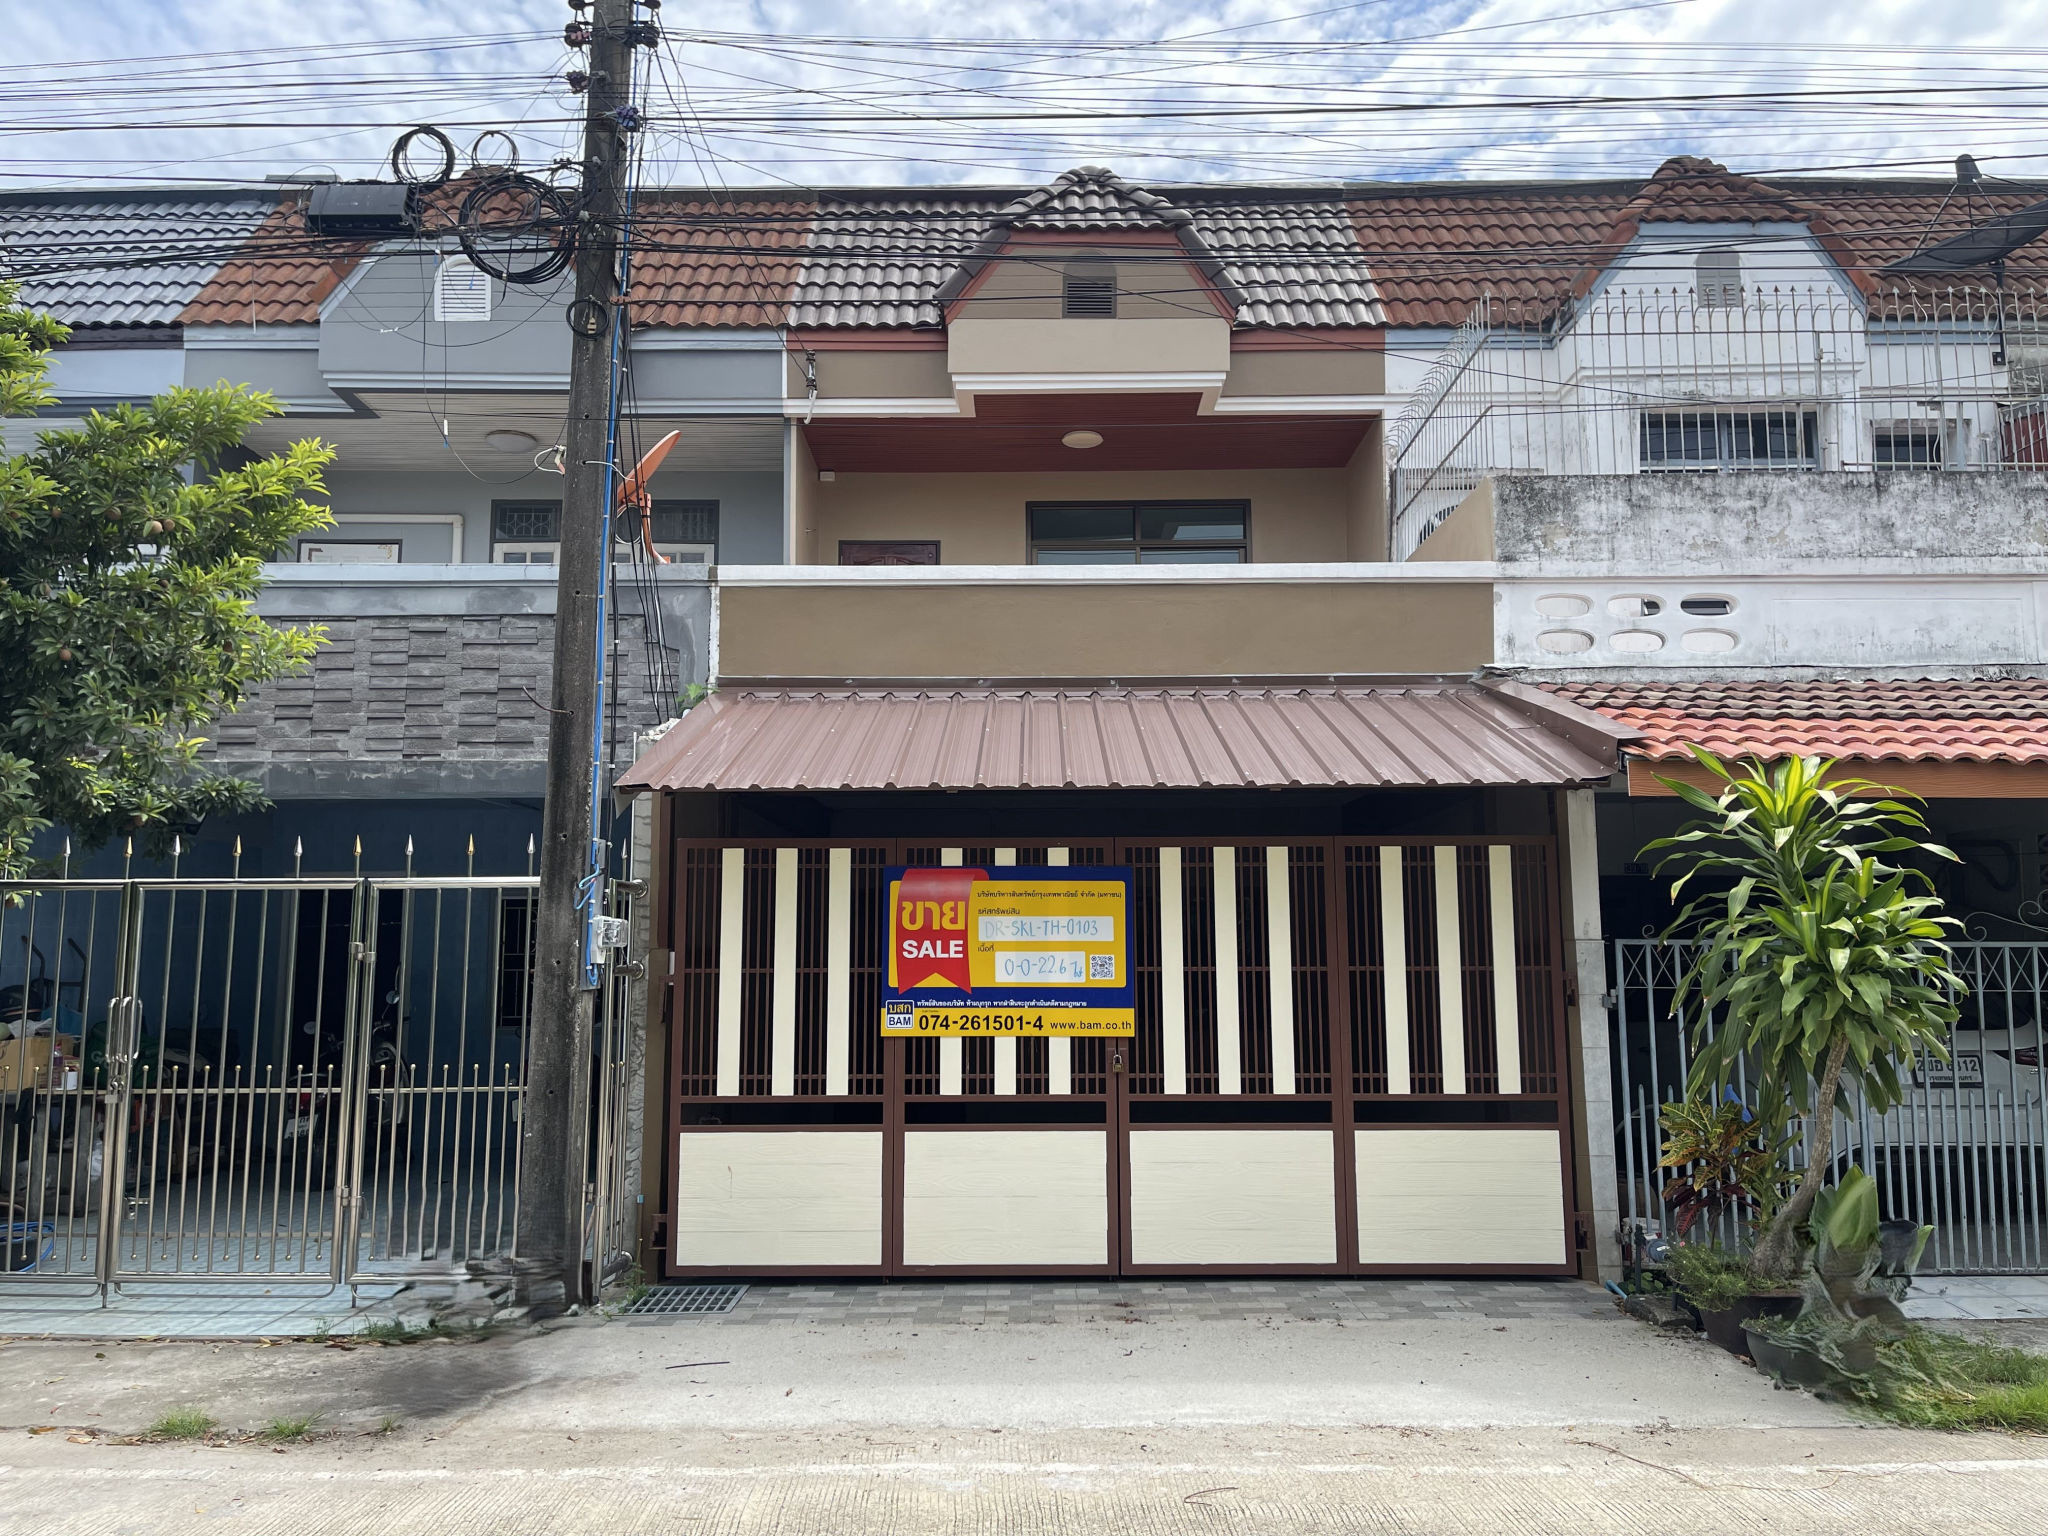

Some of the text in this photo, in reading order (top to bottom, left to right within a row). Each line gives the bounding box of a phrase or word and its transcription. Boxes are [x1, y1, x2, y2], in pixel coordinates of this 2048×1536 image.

[902, 901, 966, 931] ขาย
[902, 939, 964, 959] SALE
[888, 1002, 912, 1014] บสก
[888, 1016, 911, 1026] BAM
[919, 1014, 1132, 1031] 074-261501-4 www.bam.co.th
